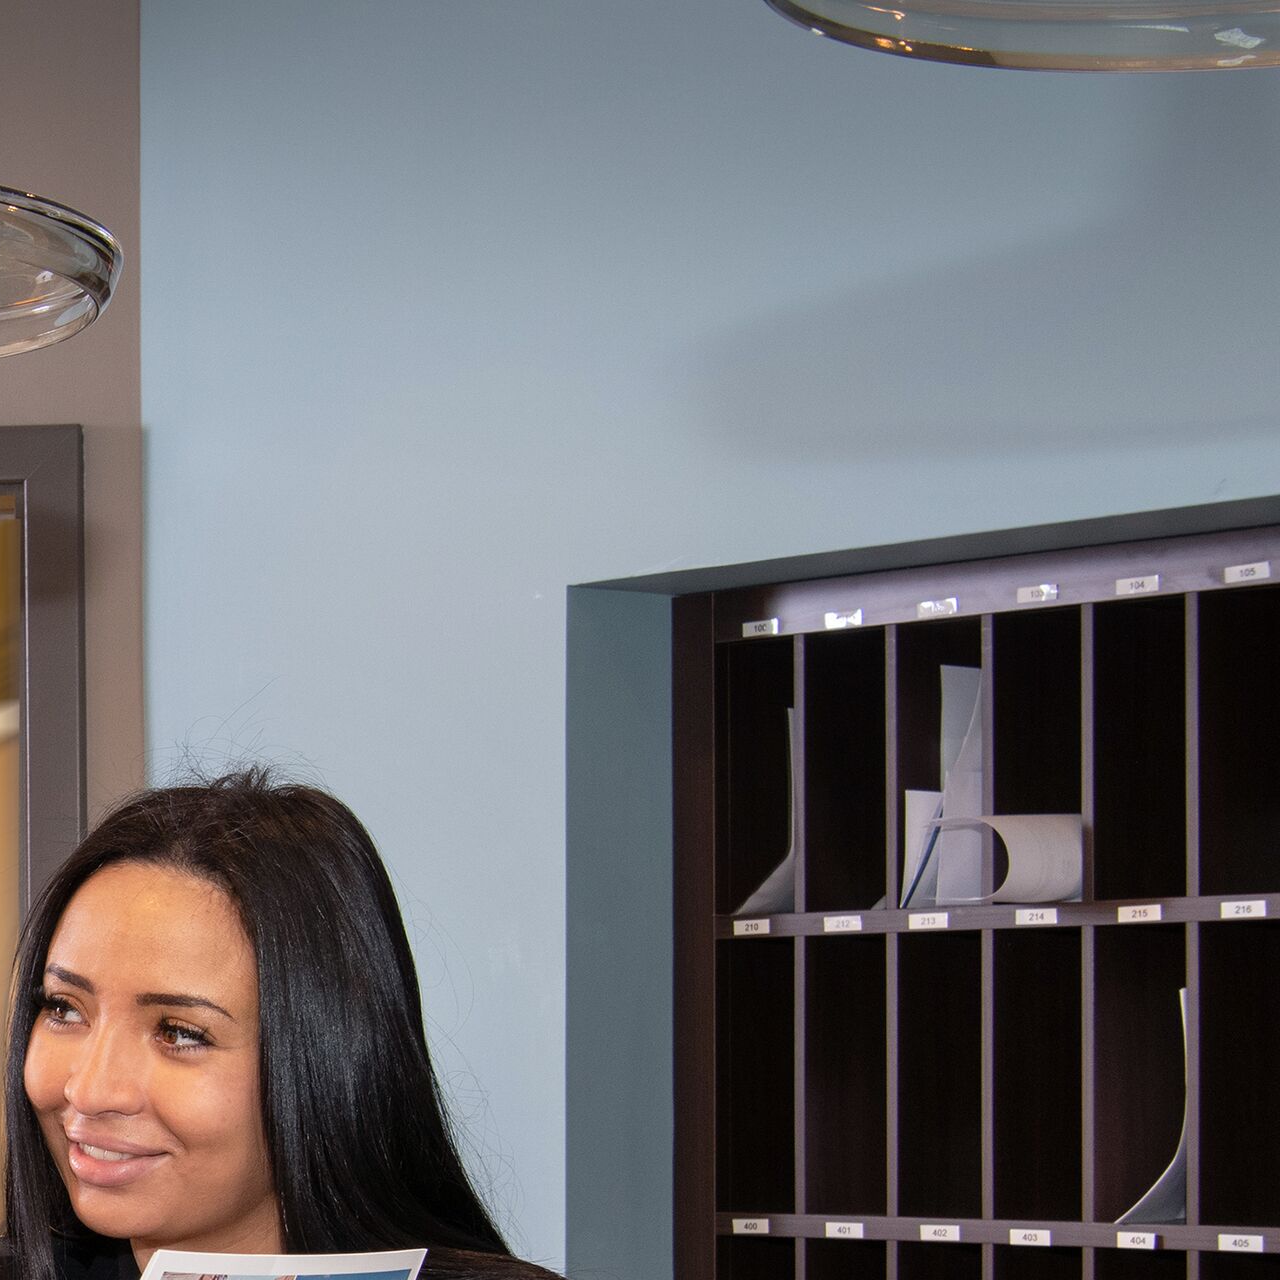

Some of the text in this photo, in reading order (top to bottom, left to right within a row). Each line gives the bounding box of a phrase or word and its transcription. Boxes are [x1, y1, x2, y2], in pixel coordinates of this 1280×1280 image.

[1240, 568, 1256, 577] 105
[1130, 581, 1145, 590] 104
[1132, 909, 1148, 918] 215
[1235, 905, 1252, 914] 216
[921, 916, 936, 925] 213
[1029, 912, 1044, 921] 214
[744, 923, 758, 932] 210
[835, 920, 850, 928] 212
[744, 1222, 758, 1230] 400
[837, 1226, 851, 1234] 401
[933, 1229, 947, 1237] 402
[1022, 1233, 1038, 1242] 403
[1130, 1236, 1146, 1245] 404
[1232, 1238, 1250, 1248] 405
